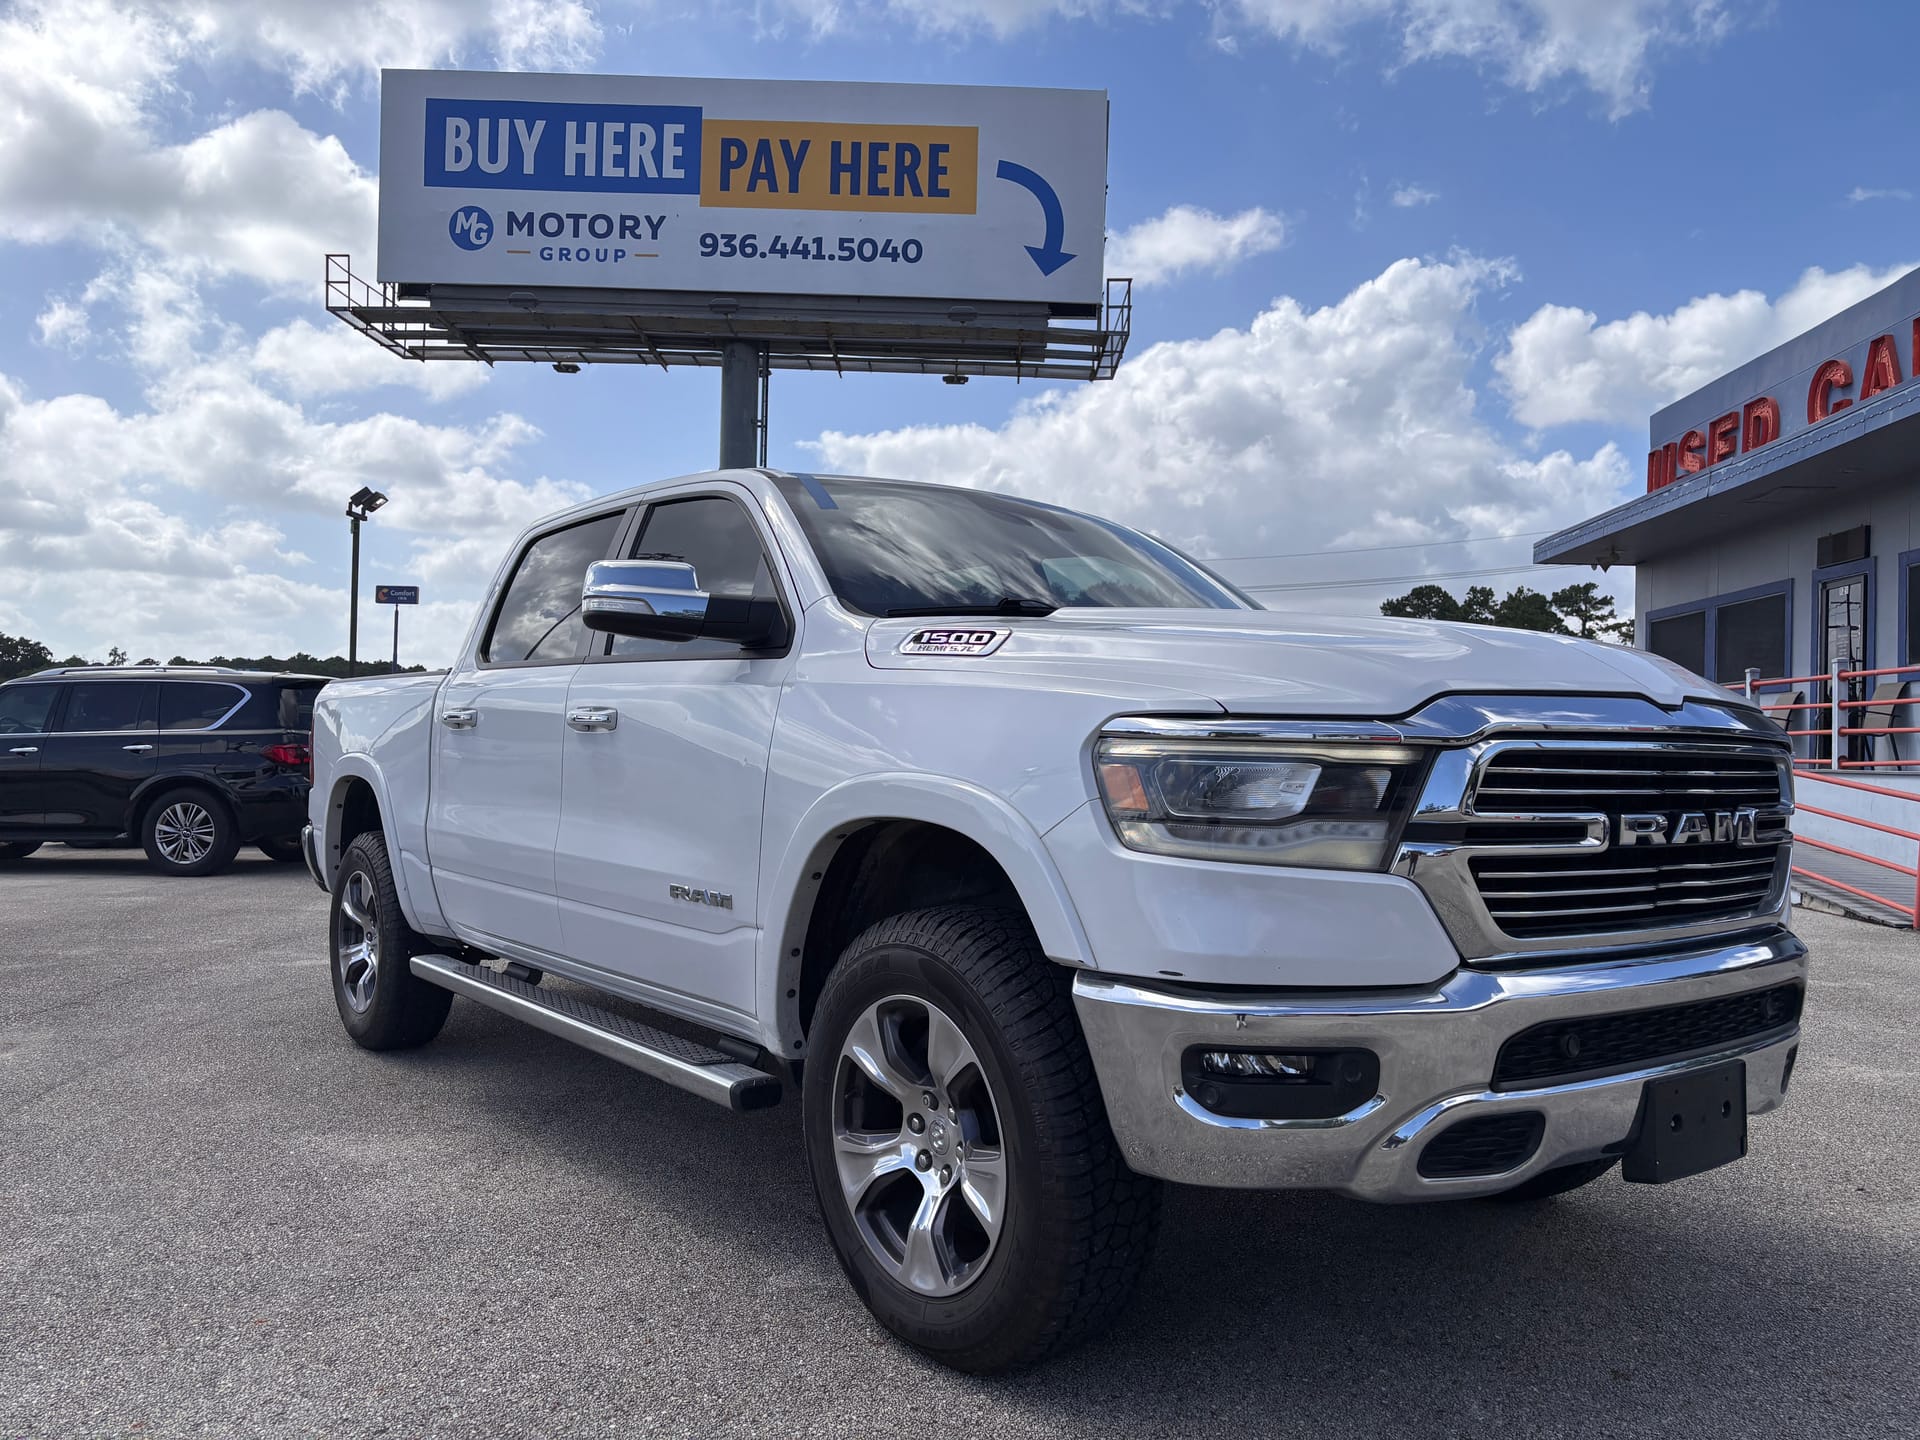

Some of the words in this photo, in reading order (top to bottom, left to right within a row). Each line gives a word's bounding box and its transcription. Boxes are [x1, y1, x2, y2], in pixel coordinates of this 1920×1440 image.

[444, 116, 546, 175] BUY
[564, 120, 685, 179] HERE
[719, 137, 811, 193] PAY
[829, 140, 950, 197] HERE
[454, 211, 489, 245] MG
[506, 210, 667, 240] MOTORY
[539, 246, 626, 263] GROUP
[699, 232, 923, 263] 936.441.5040
[1647, 396, 1781, 494] USED
[1807, 316, 1920, 425] CA
[920, 632, 991, 643] 1500
[1619, 811, 1757, 847] RAM
[669, 882, 733, 910] RAM
